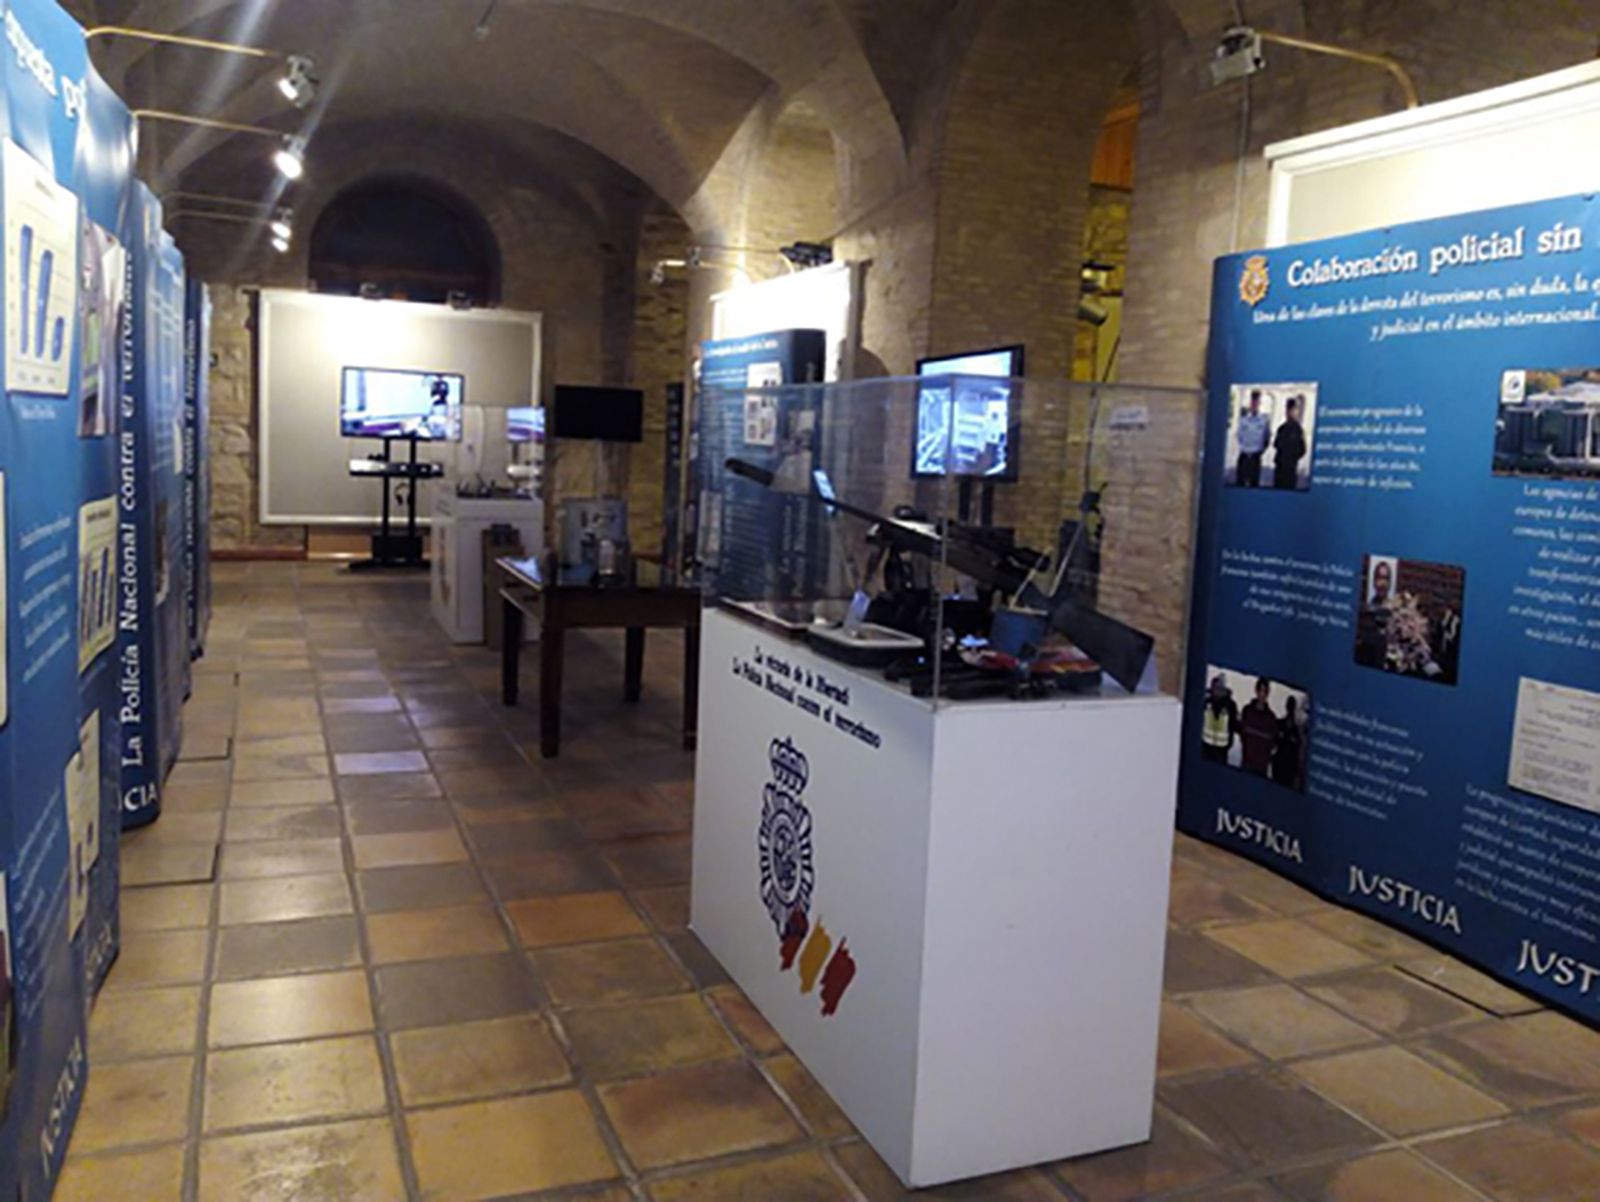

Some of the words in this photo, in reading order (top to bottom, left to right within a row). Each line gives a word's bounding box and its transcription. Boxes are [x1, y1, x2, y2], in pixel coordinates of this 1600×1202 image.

[1287, 246, 1418, 287] Colaboración
[1430, 225, 1525, 275] policial
[1537, 222, 1582, 254] sin
[119, 523, 139, 630] Nacional
[120, 644, 141, 723] Policía
[121, 735, 143, 766] La
[1216, 807, 1304, 864] JUSTICIA
[1348, 865, 1462, 935] JUSTICIA
